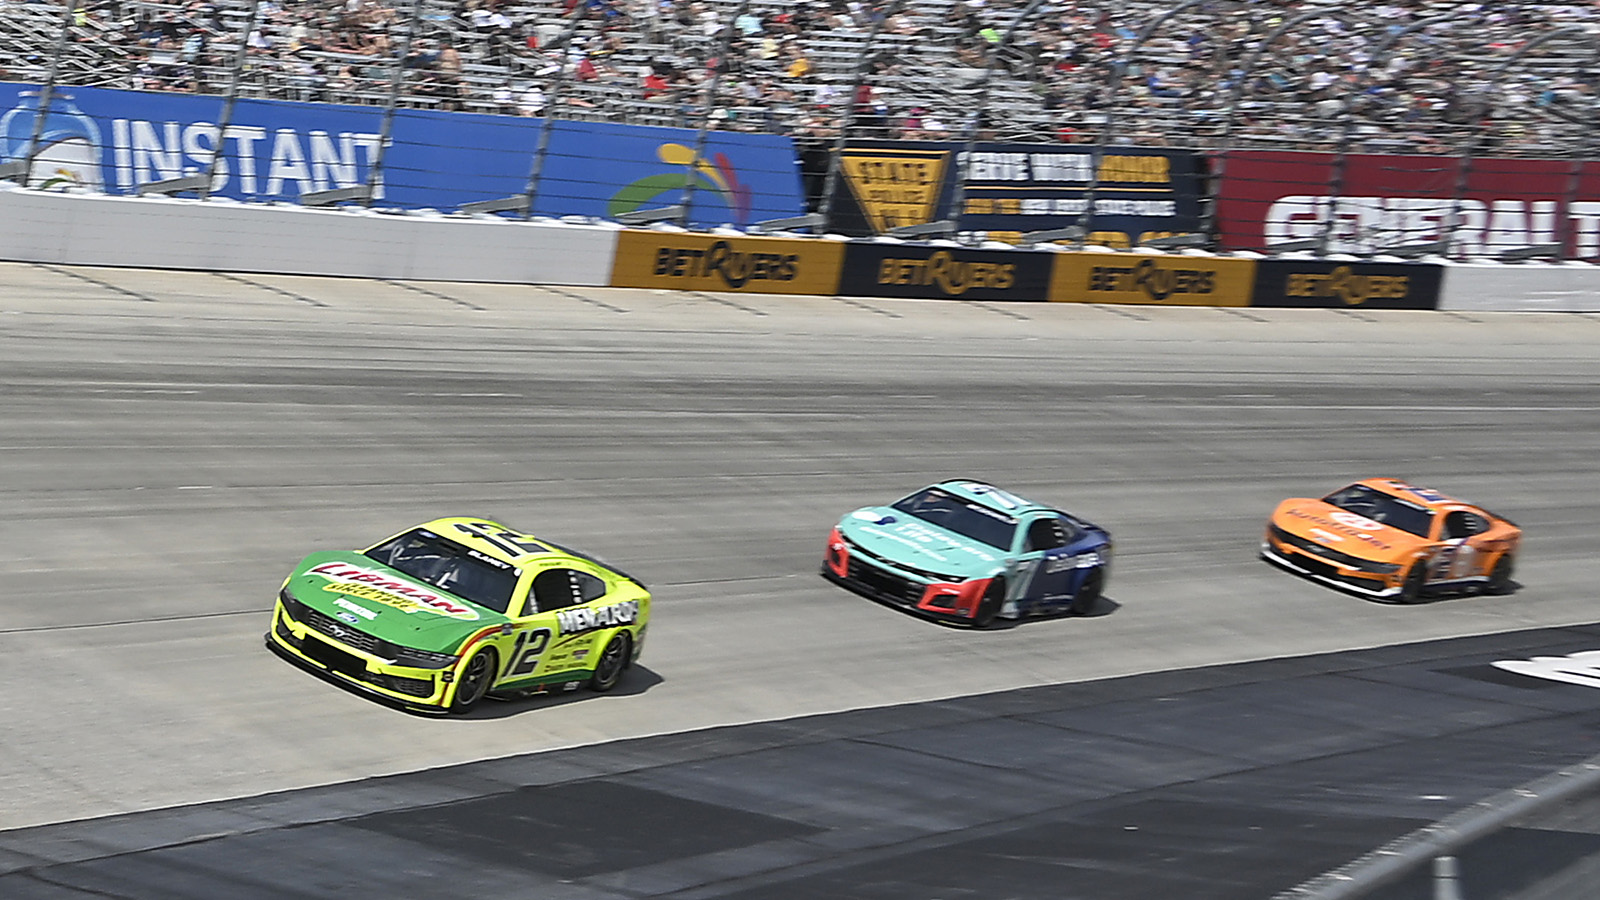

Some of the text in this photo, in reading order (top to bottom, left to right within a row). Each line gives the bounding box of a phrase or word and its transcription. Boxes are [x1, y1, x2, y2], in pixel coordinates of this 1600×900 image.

[112, 118, 392, 200] INSTANT
[1265, 196, 1562, 259] GENERAL
[310, 564, 469, 613] LIBMAN
[501, 627, 552, 678] 12
